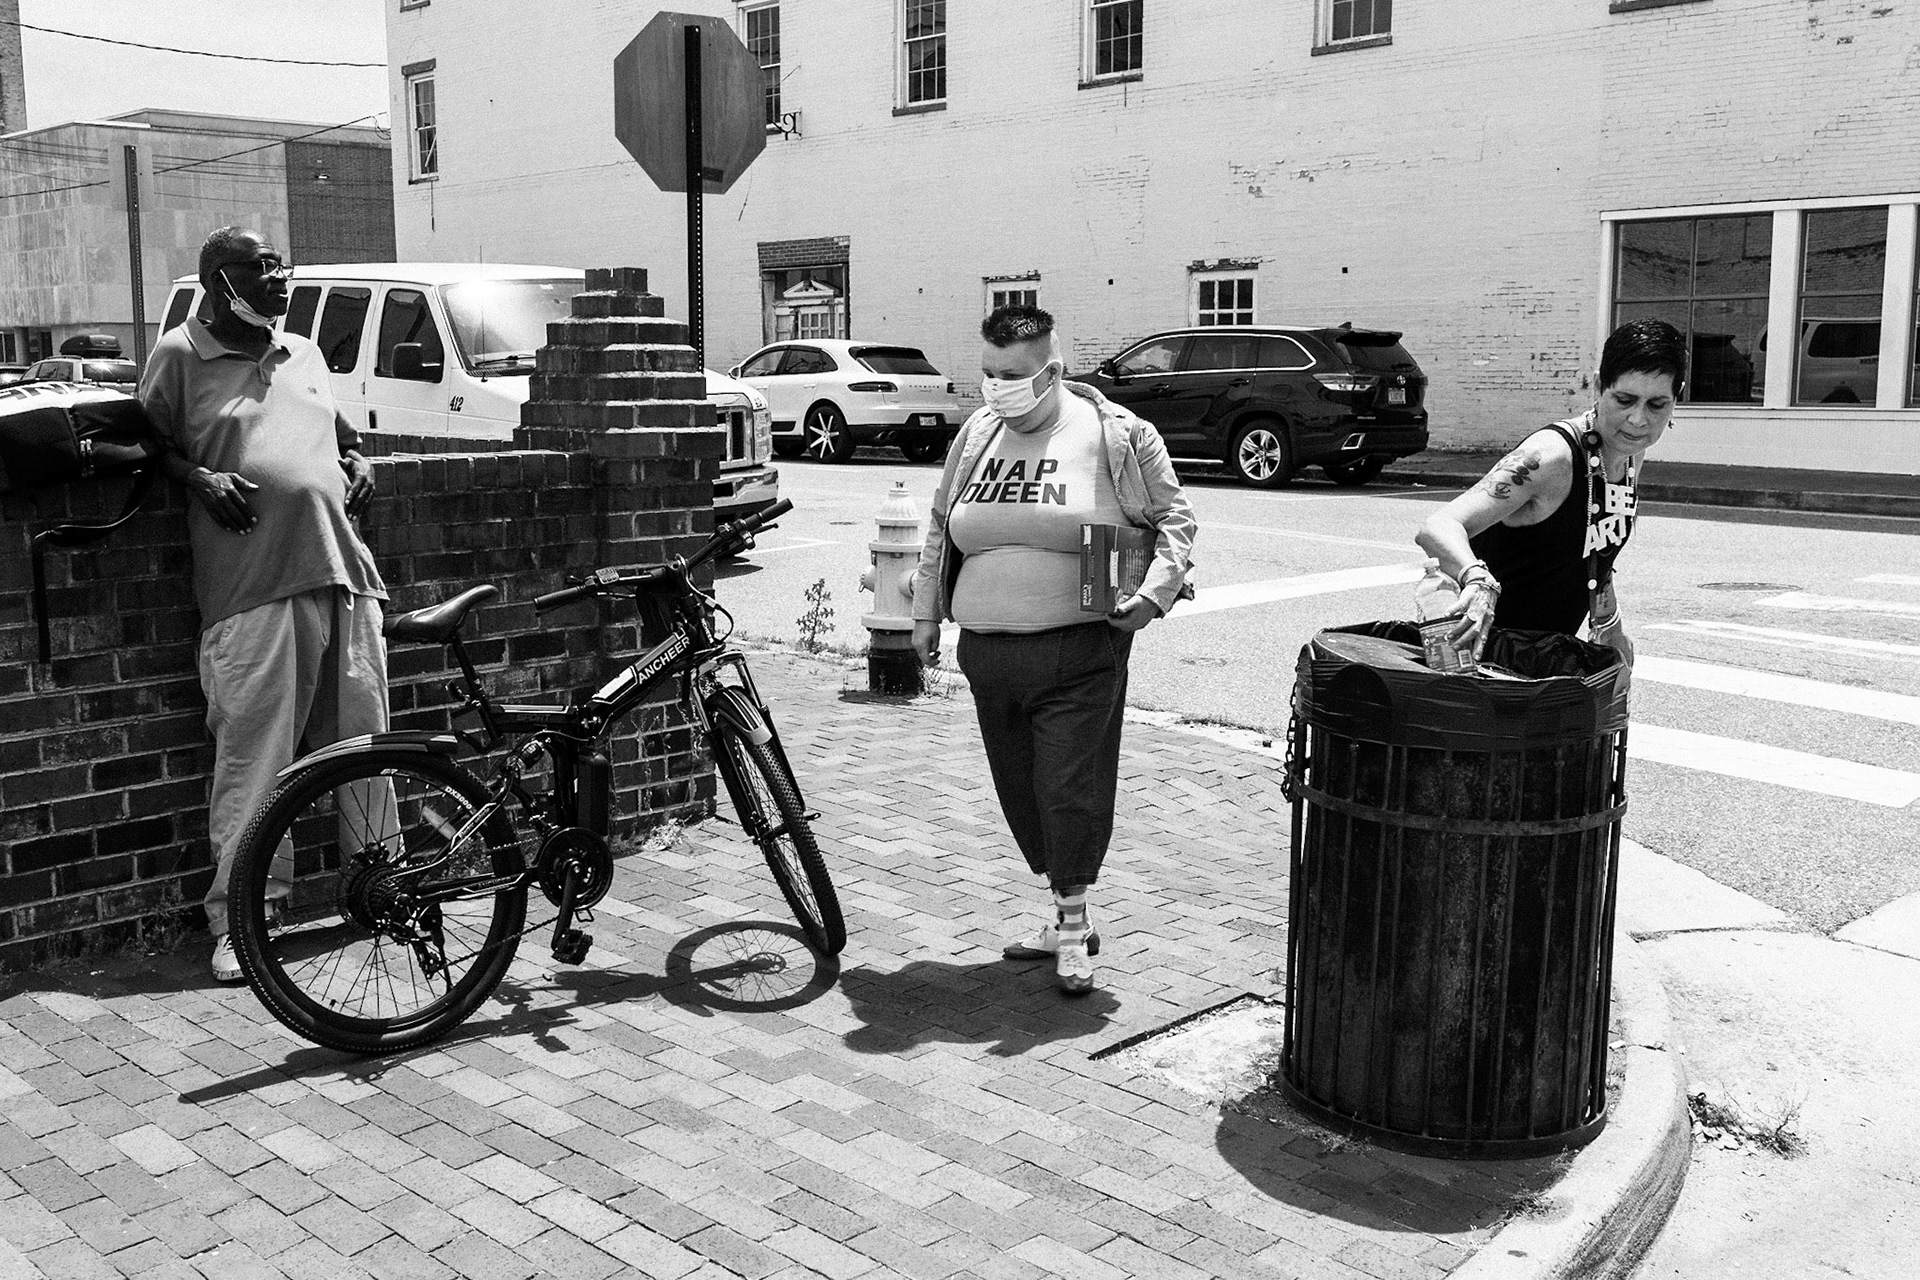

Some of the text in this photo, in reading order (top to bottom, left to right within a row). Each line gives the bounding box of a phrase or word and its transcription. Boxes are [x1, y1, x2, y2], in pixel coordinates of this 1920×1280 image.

[450, 396, 464, 412] 412
[980, 458, 1058, 481] NAP
[960, 481, 1066, 505] QUEEN
[1605, 483, 1635, 516] BE
[639, 637, 691, 684] ANCHEER
